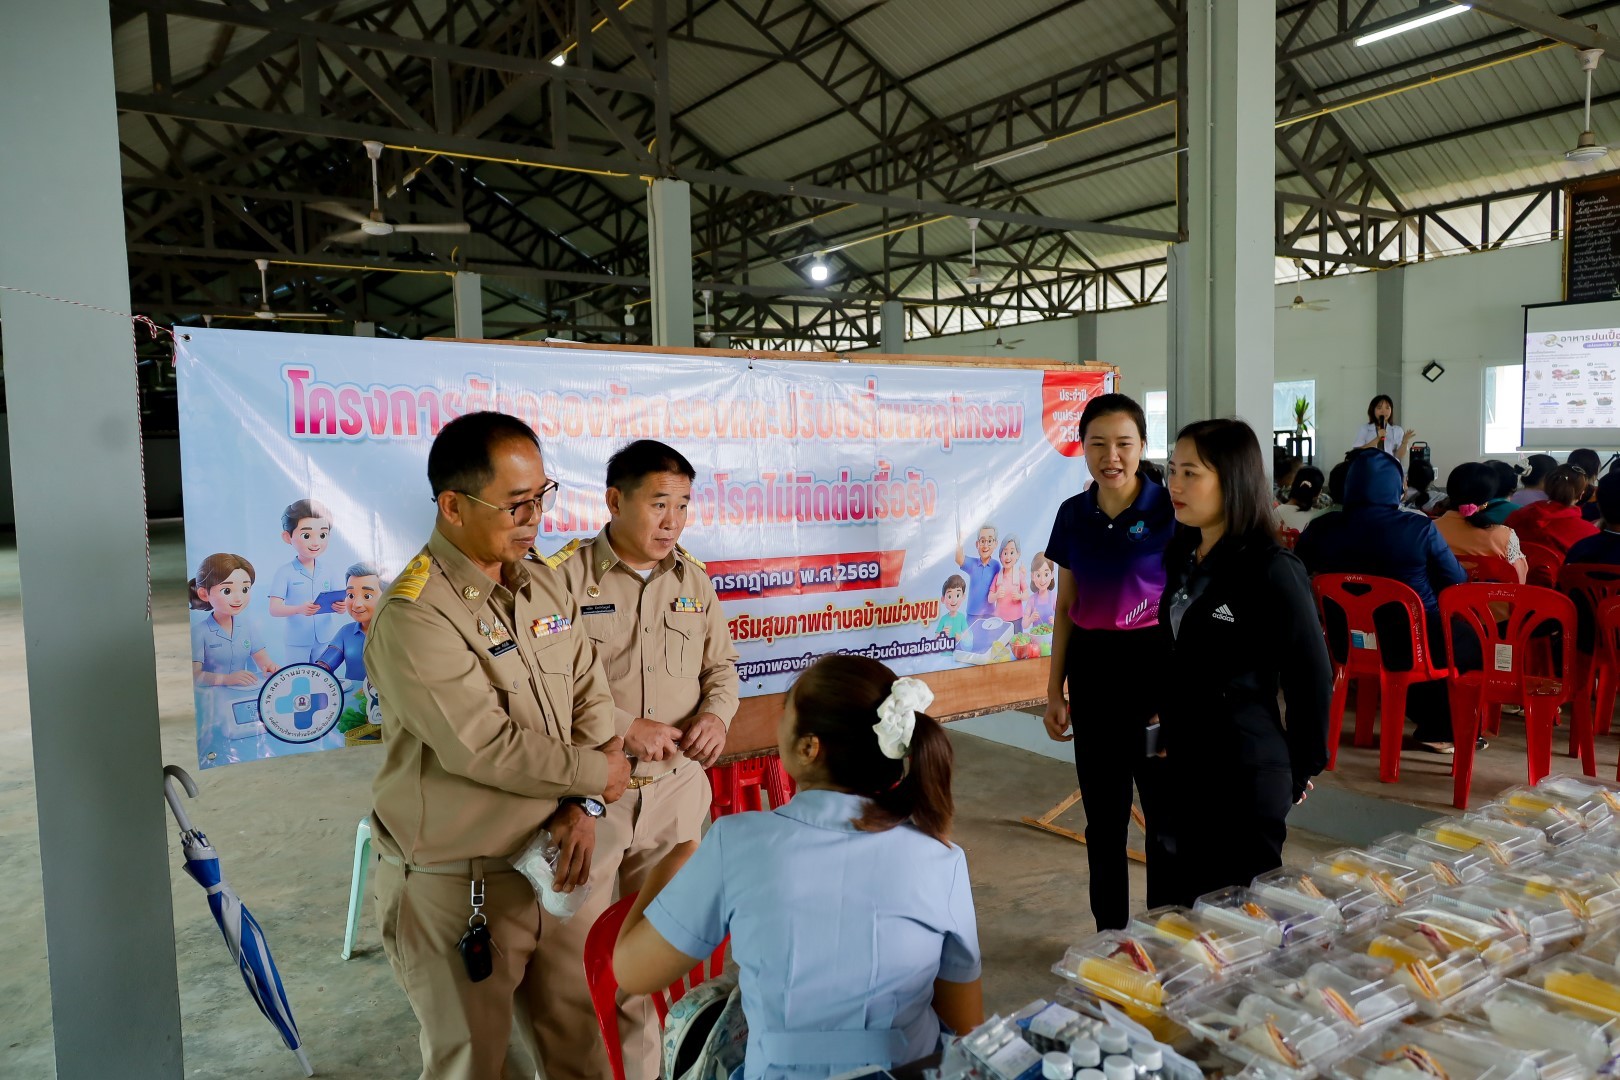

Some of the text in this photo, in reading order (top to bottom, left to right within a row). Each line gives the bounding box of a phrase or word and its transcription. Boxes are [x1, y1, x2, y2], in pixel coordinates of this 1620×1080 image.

[1560, 329, 1620, 343] อาหารปนเปื้อ
[1059, 388, 1087, 401] ประจำปี
[1052, 409, 1083, 421] งบประม
[1059, 426, 1081, 443] 256
[711, 563, 879, 592] กรกฎาคม พ.ศ.2569
[727, 598, 939, 643] สริมสุขภาพตำบลบ้านม่วงชุม
[1212, 612, 1234, 623] adidas
